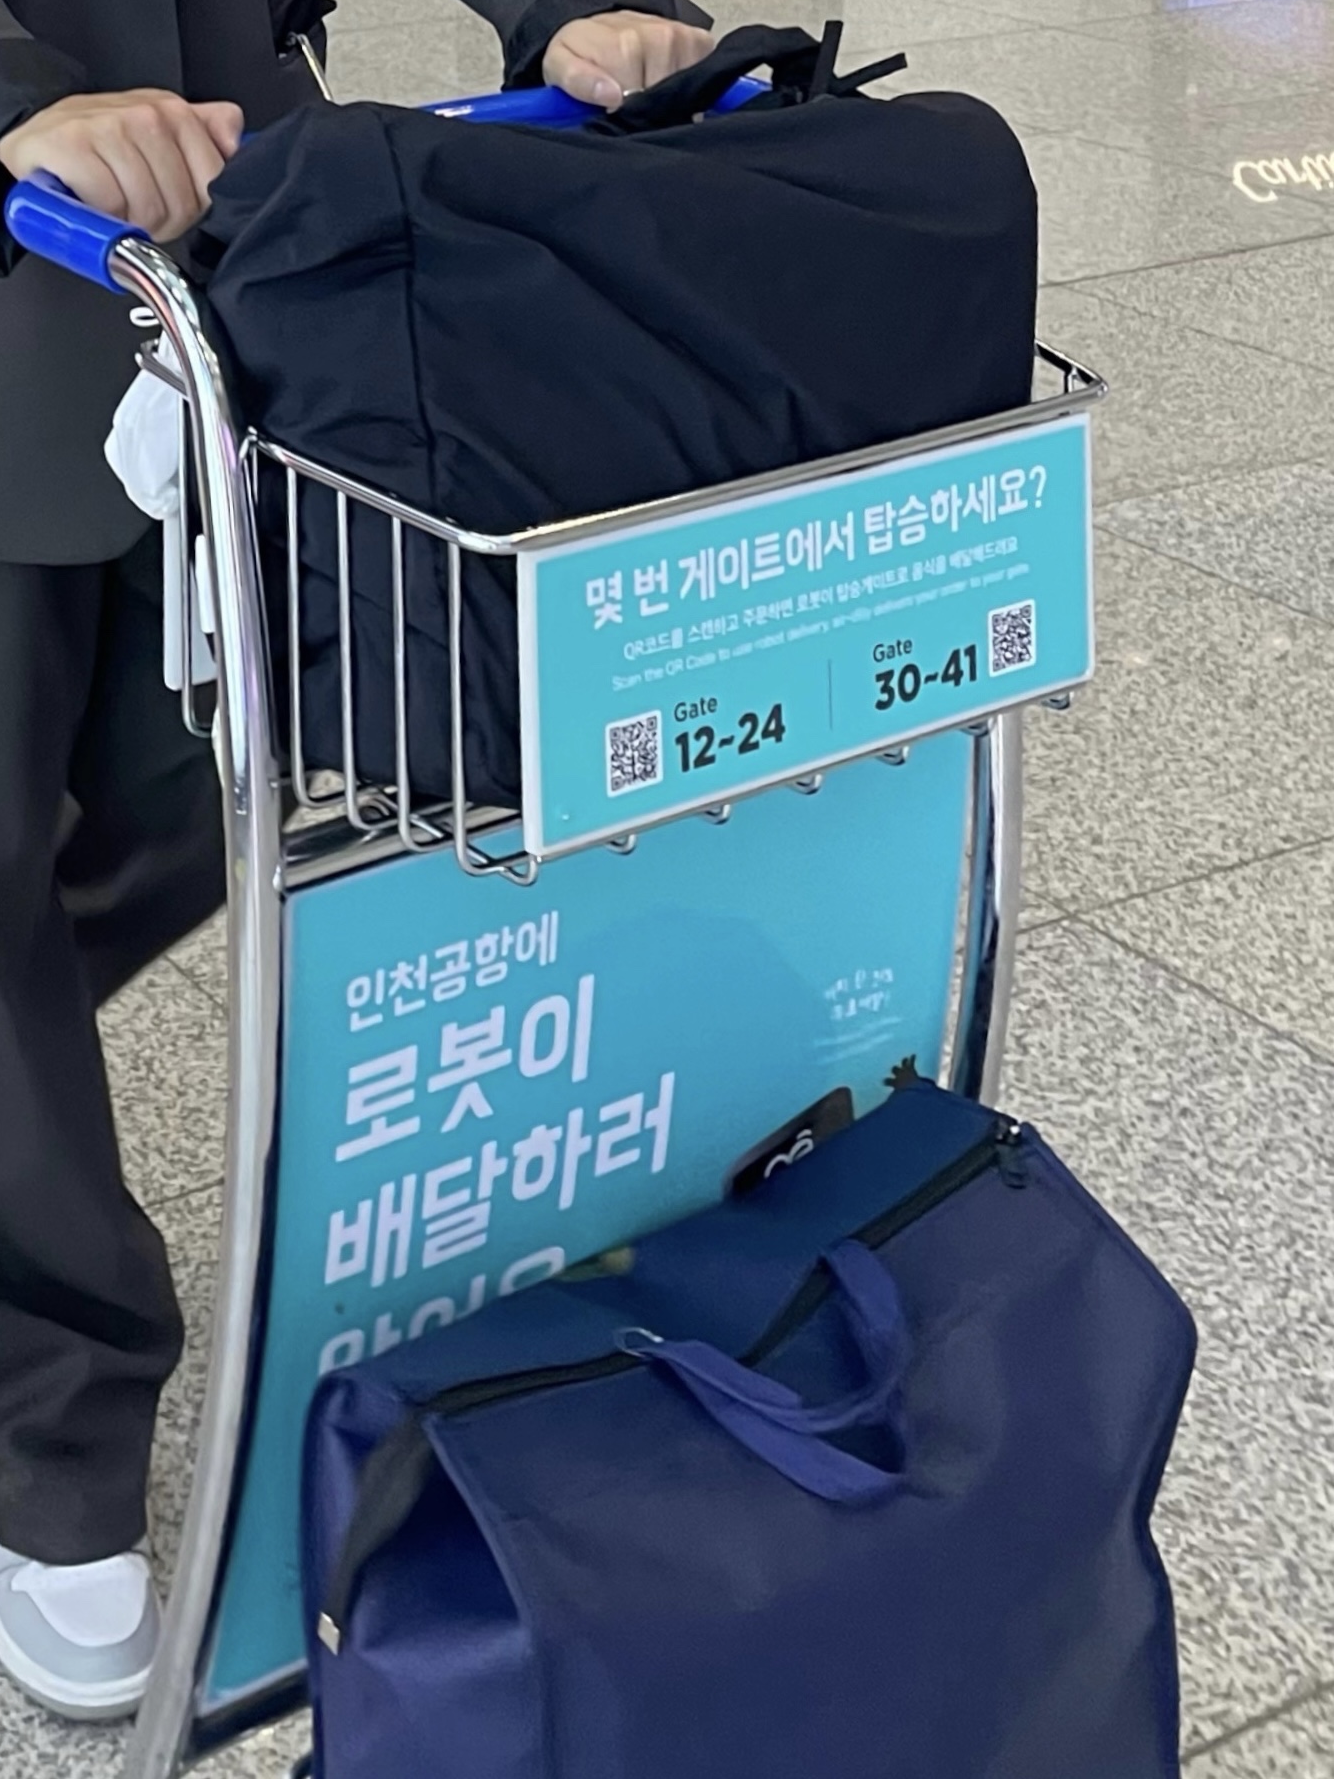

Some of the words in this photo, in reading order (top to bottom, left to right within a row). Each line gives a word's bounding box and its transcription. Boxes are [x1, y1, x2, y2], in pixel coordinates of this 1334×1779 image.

[585, 570, 624, 631] 몇
[633, 558, 670, 617] 번
[678, 511, 856, 601] 게이트에서
[864, 464, 1048, 556] 탑승하세요?
[623, 627, 684, 661] QR코드를
[796, 585, 834, 613] 로봇이
[836, 566, 910, 603] 탑승게이트로
[873, 637, 913, 664] Gate
[611, 673, 643, 692] Scan
[644, 665, 664, 683] the
[665, 657, 684, 677] QR
[673, 696, 719, 723] Gate
[874, 644, 979, 712] 30~41
[674, 703, 787, 773] 12~24
[346, 909, 559, 1034] 인천공항에
[334, 973, 596, 1163] 로봇이
[323, 1070, 676, 1289] 배달하러
